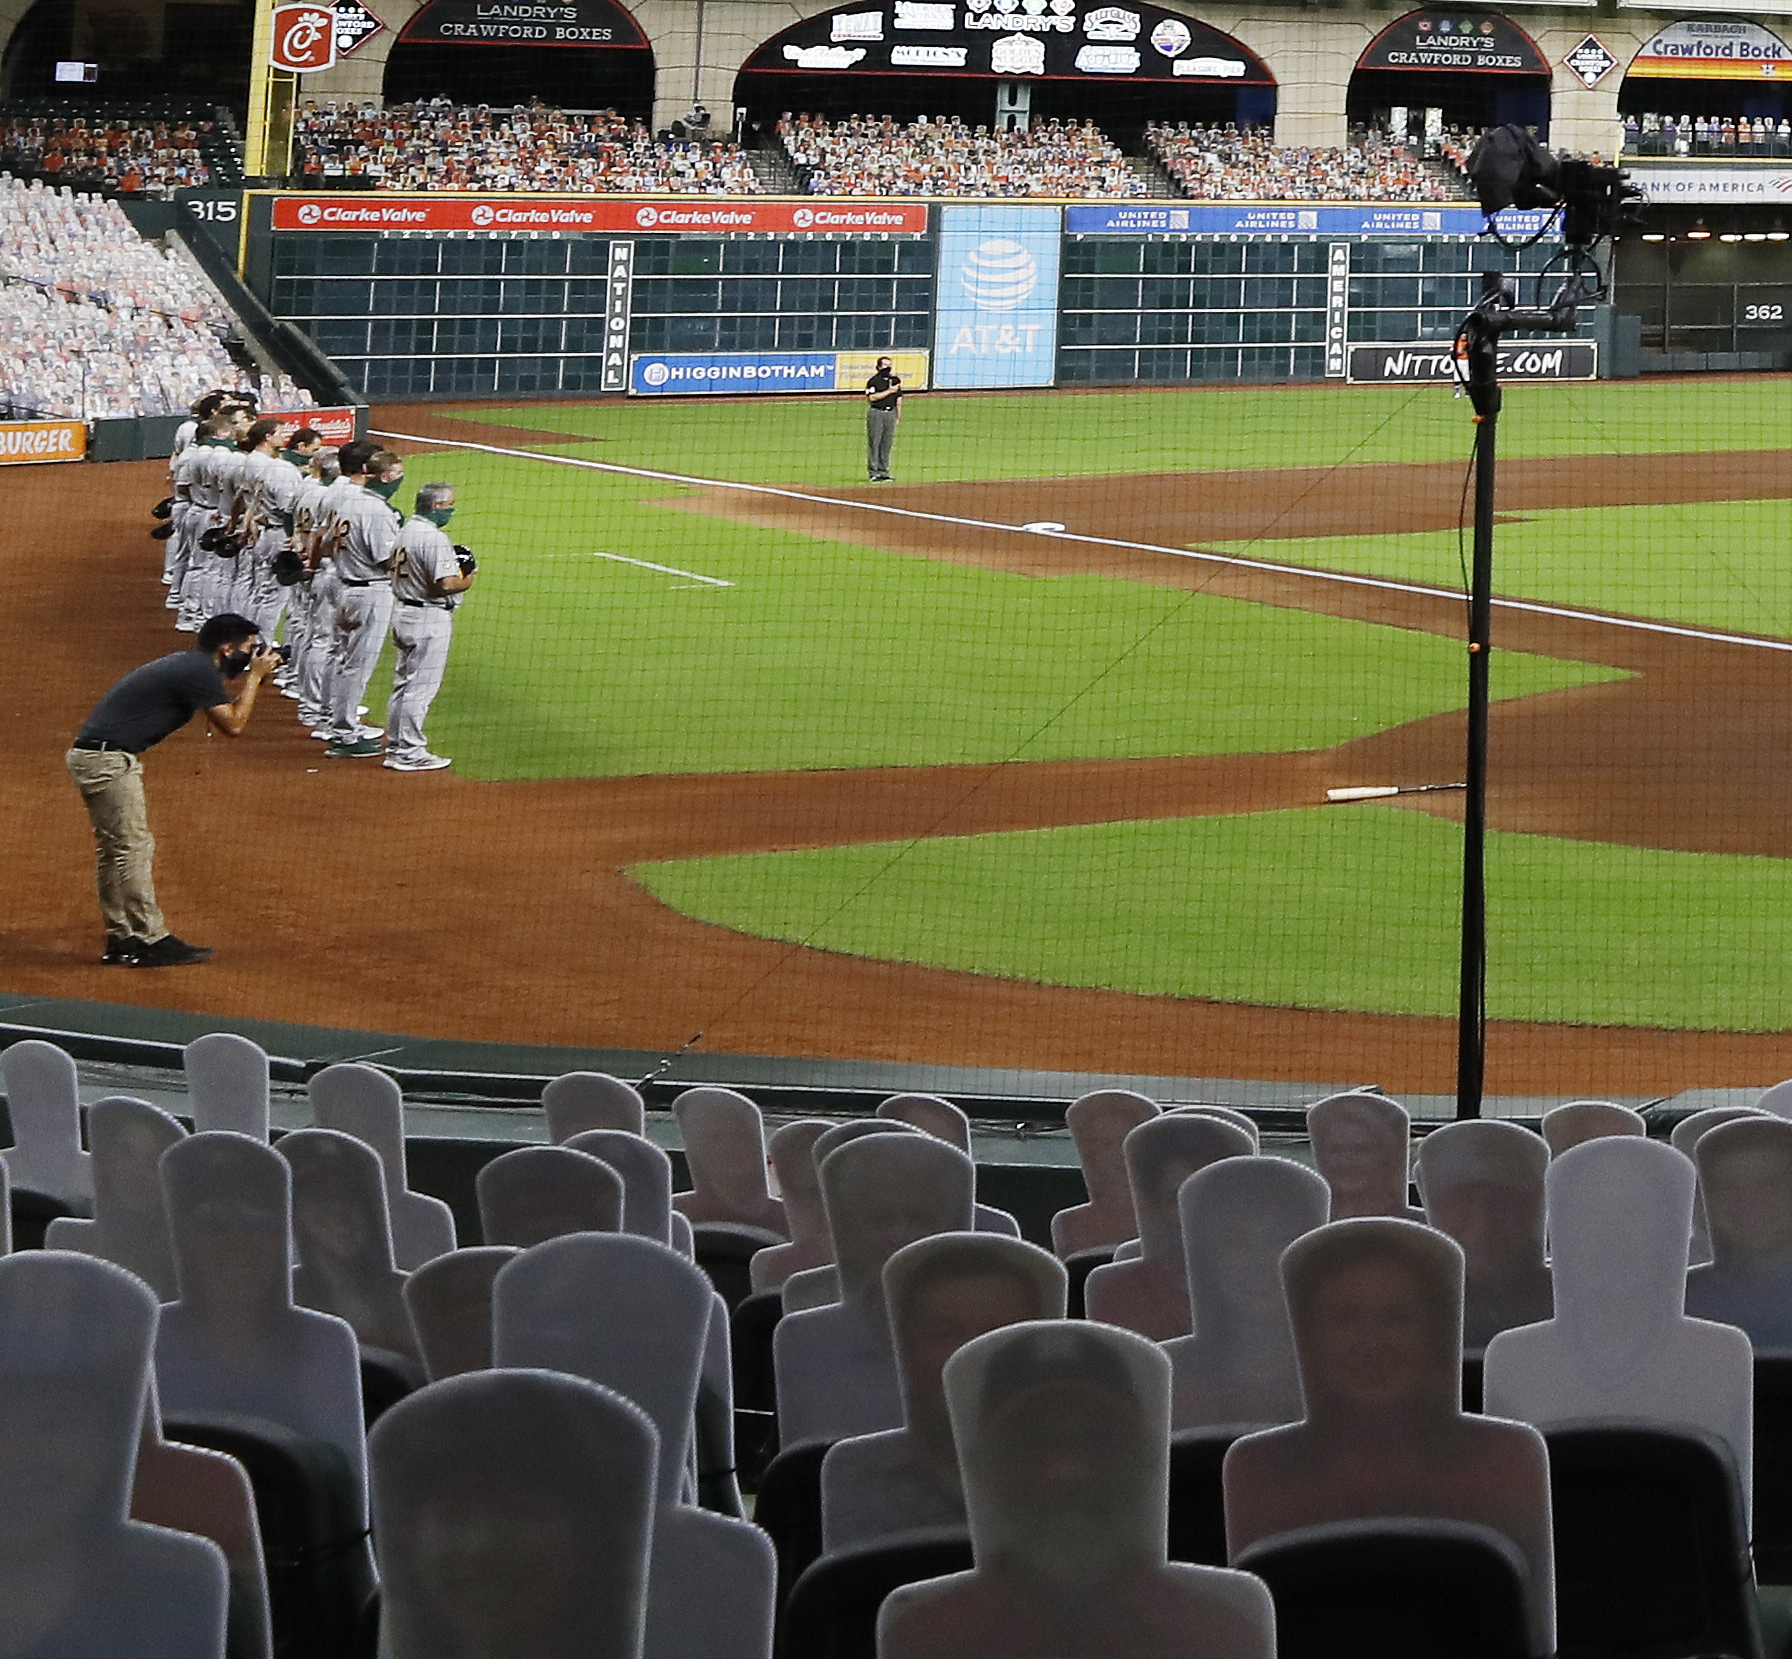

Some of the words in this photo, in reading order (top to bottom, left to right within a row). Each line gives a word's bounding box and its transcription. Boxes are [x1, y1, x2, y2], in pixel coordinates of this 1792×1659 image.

[476, 2, 578, 21] LANDRY'S
[439, 23, 549, 40] CRAWFORD
[555, 25, 612, 41] BOXES
[1415, 34, 1494, 50] LANDRY'S
[1653, 39, 1734, 58] Crawford
[1739, 41, 1782, 59] Bock
[1387, 51, 1472, 67] CRAWFORD
[1477, 53, 1523, 68] BOXES
[1631, 182, 1671, 192] BANK
[1675, 182, 1695, 192] OF
[1699, 182, 1765, 193] AMERICA
[187, 201, 237, 222] 315
[1119, 211, 1167, 220] UNITED
[1106, 219, 1167, 229] AIRLINES
[606, 247, 628, 384] NATIONAL
[1329, 249, 1346, 371] AMERICAN
[1745, 305, 1783, 321] 362
[950, 323, 1041, 355] AT&T
[671, 365, 827, 379] HIGGINBOTHAM
